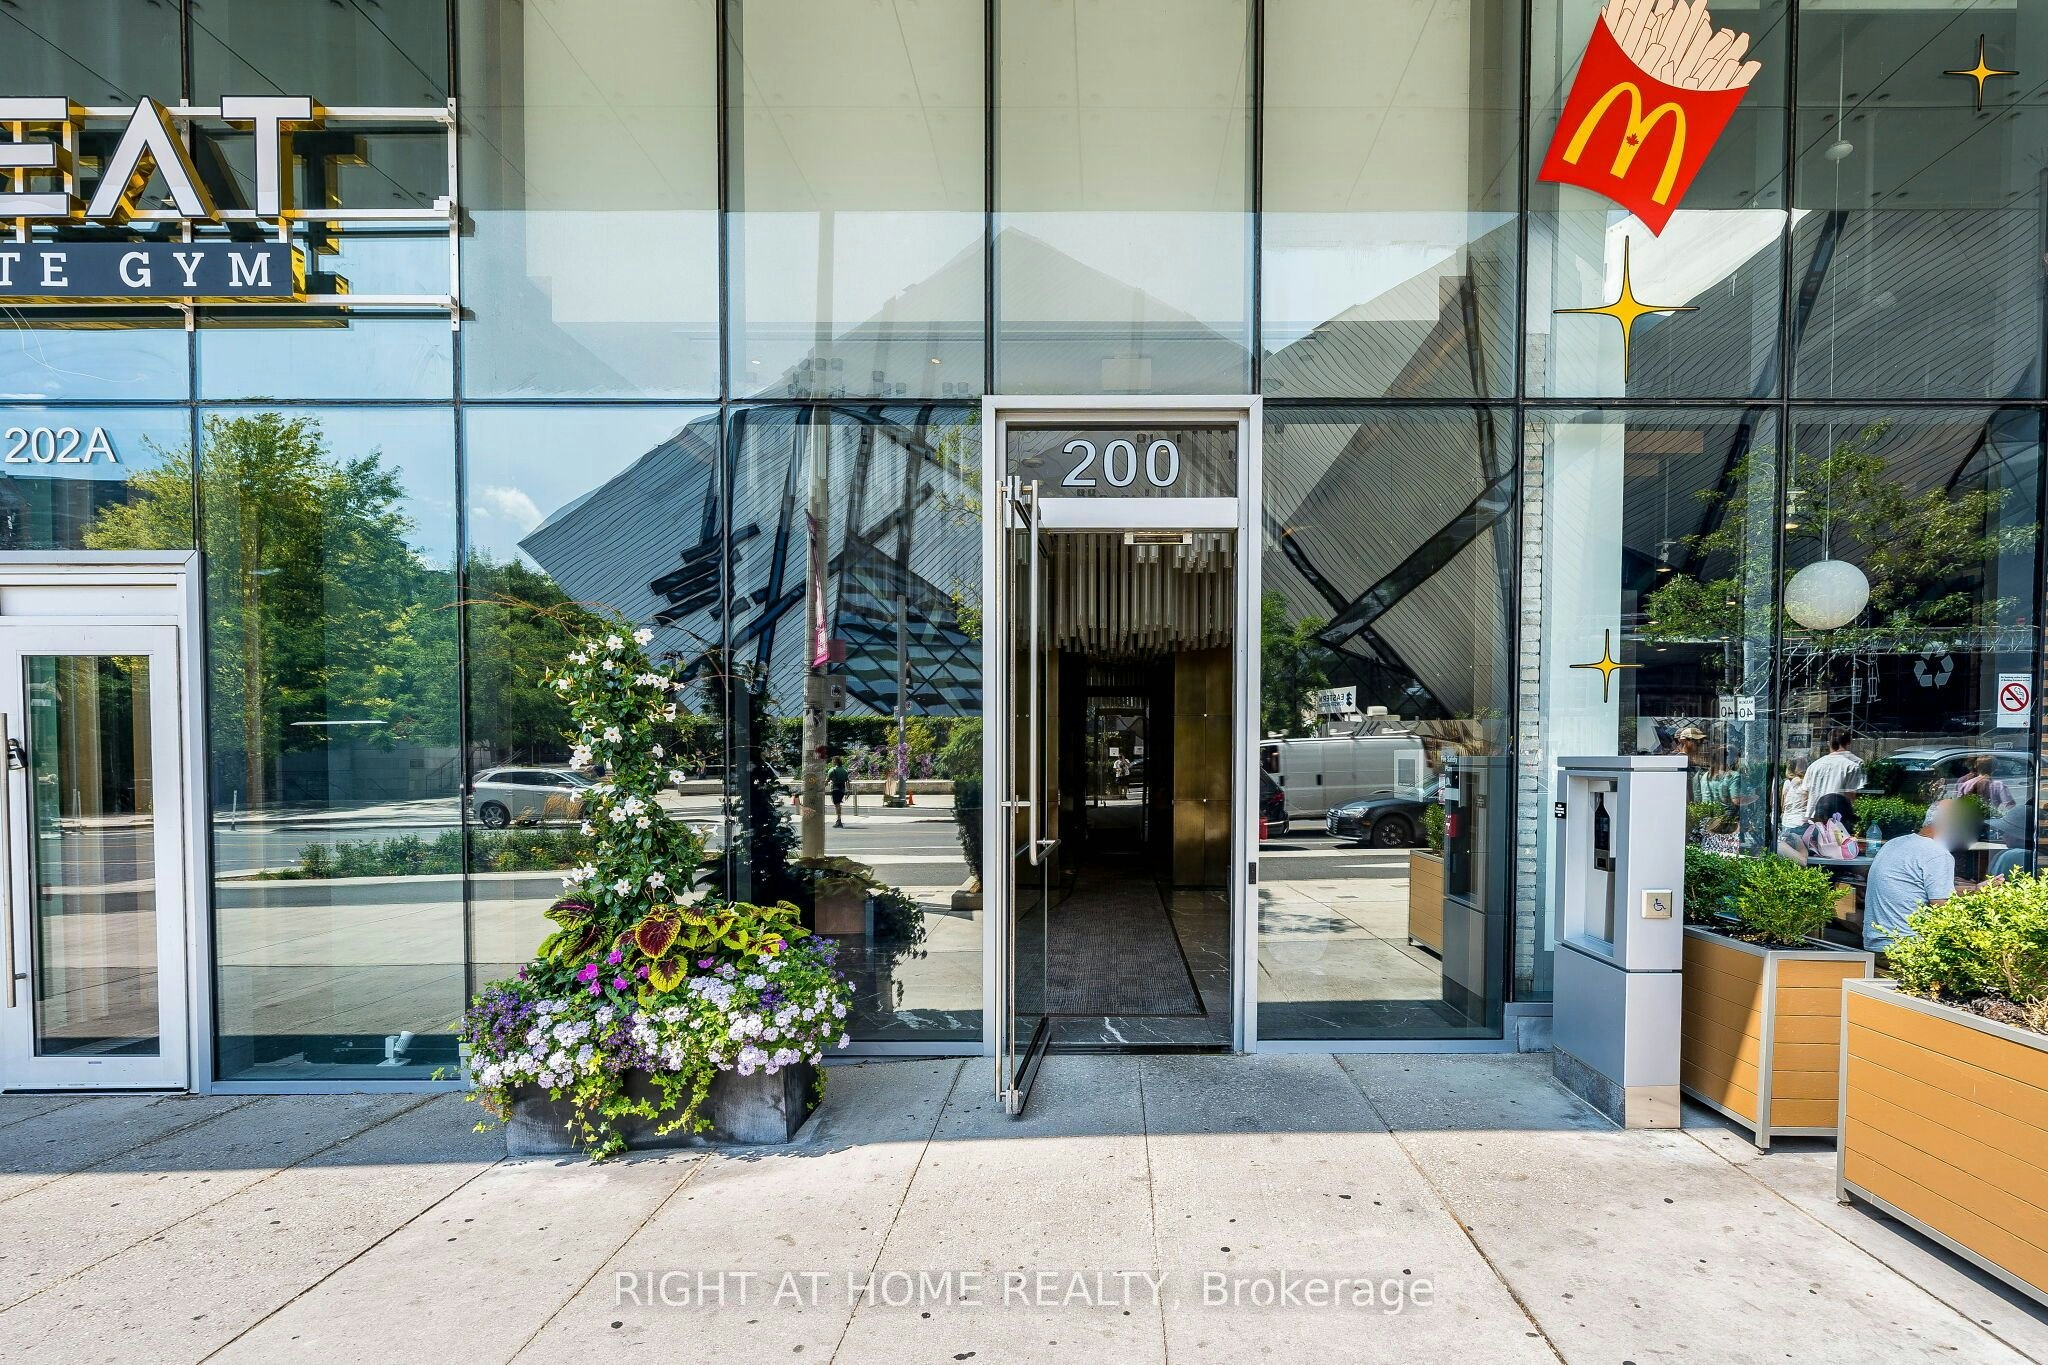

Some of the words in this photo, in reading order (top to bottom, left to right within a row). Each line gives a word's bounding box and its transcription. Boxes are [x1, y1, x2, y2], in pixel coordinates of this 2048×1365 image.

[119, 250, 272, 288] GYM
[4, 426, 119, 464] 202A
[1060, 438, 1181, 488] 200
